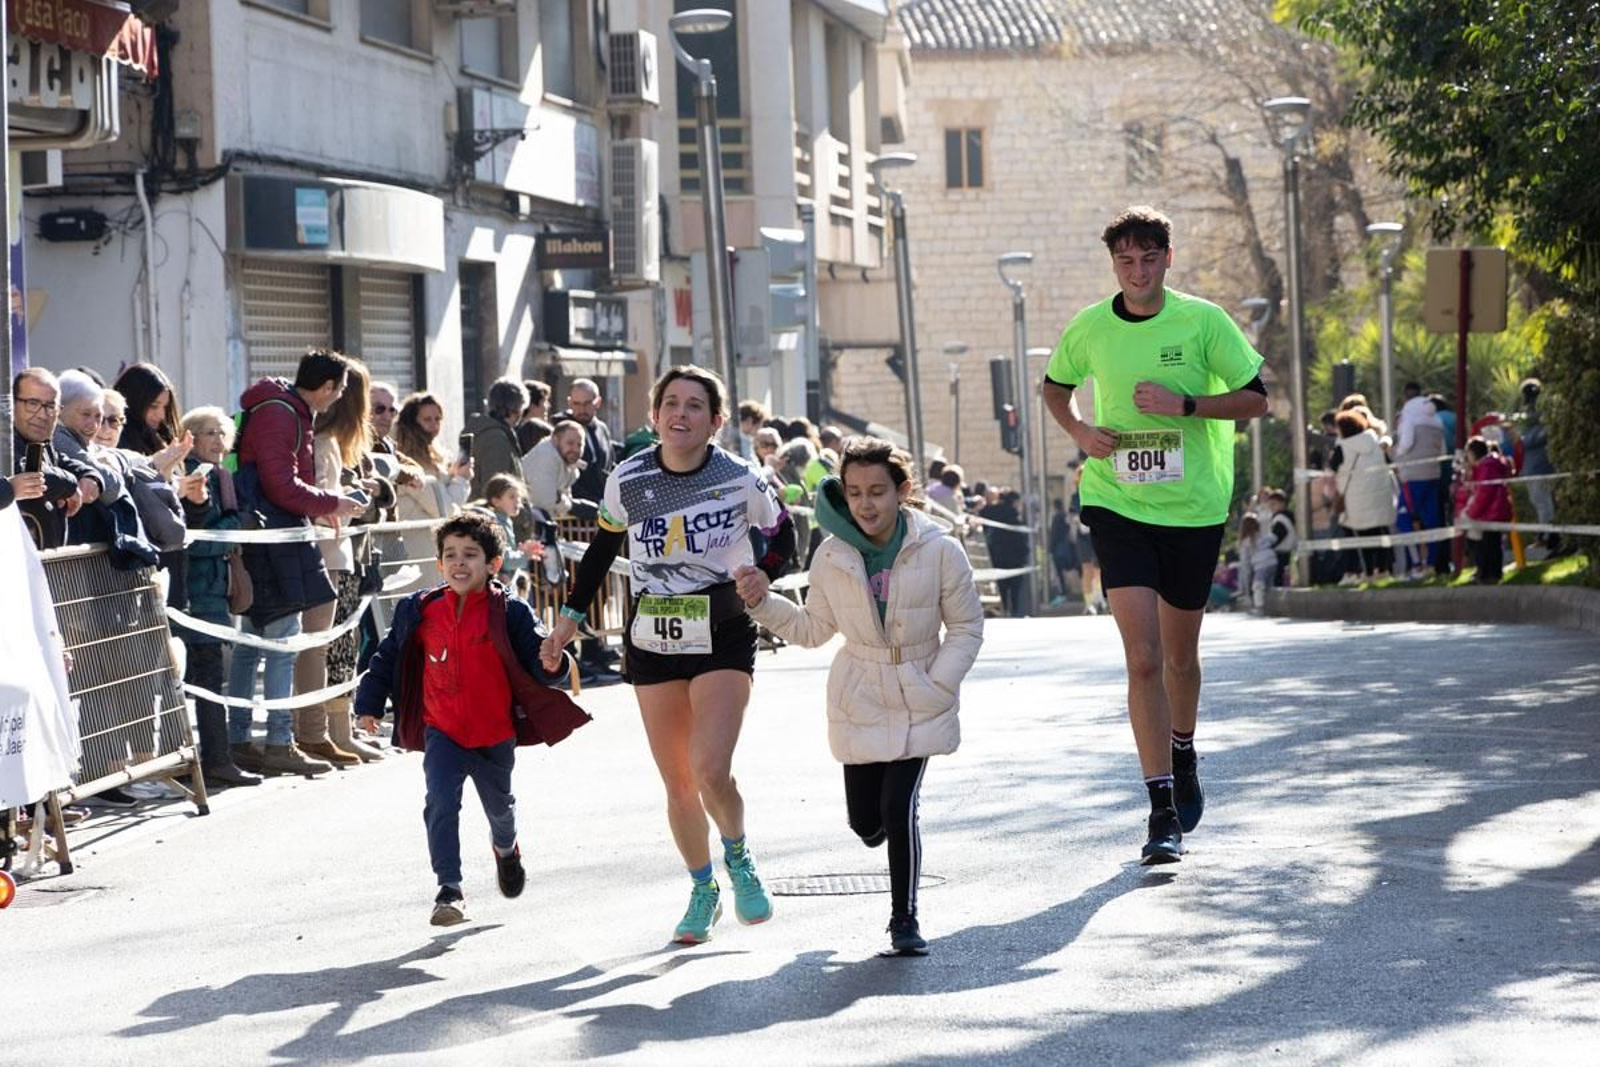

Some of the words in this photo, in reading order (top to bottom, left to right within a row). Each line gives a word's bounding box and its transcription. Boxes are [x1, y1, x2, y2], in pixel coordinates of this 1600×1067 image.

[1128, 450, 1166, 471] 804
[634, 510, 734, 541] JABALCUZ
[641, 532, 703, 558] TRAIL
[702, 532, 731, 558] Jaén
[654, 617, 683, 640] 46
[6, 735, 26, 756] Jaé
